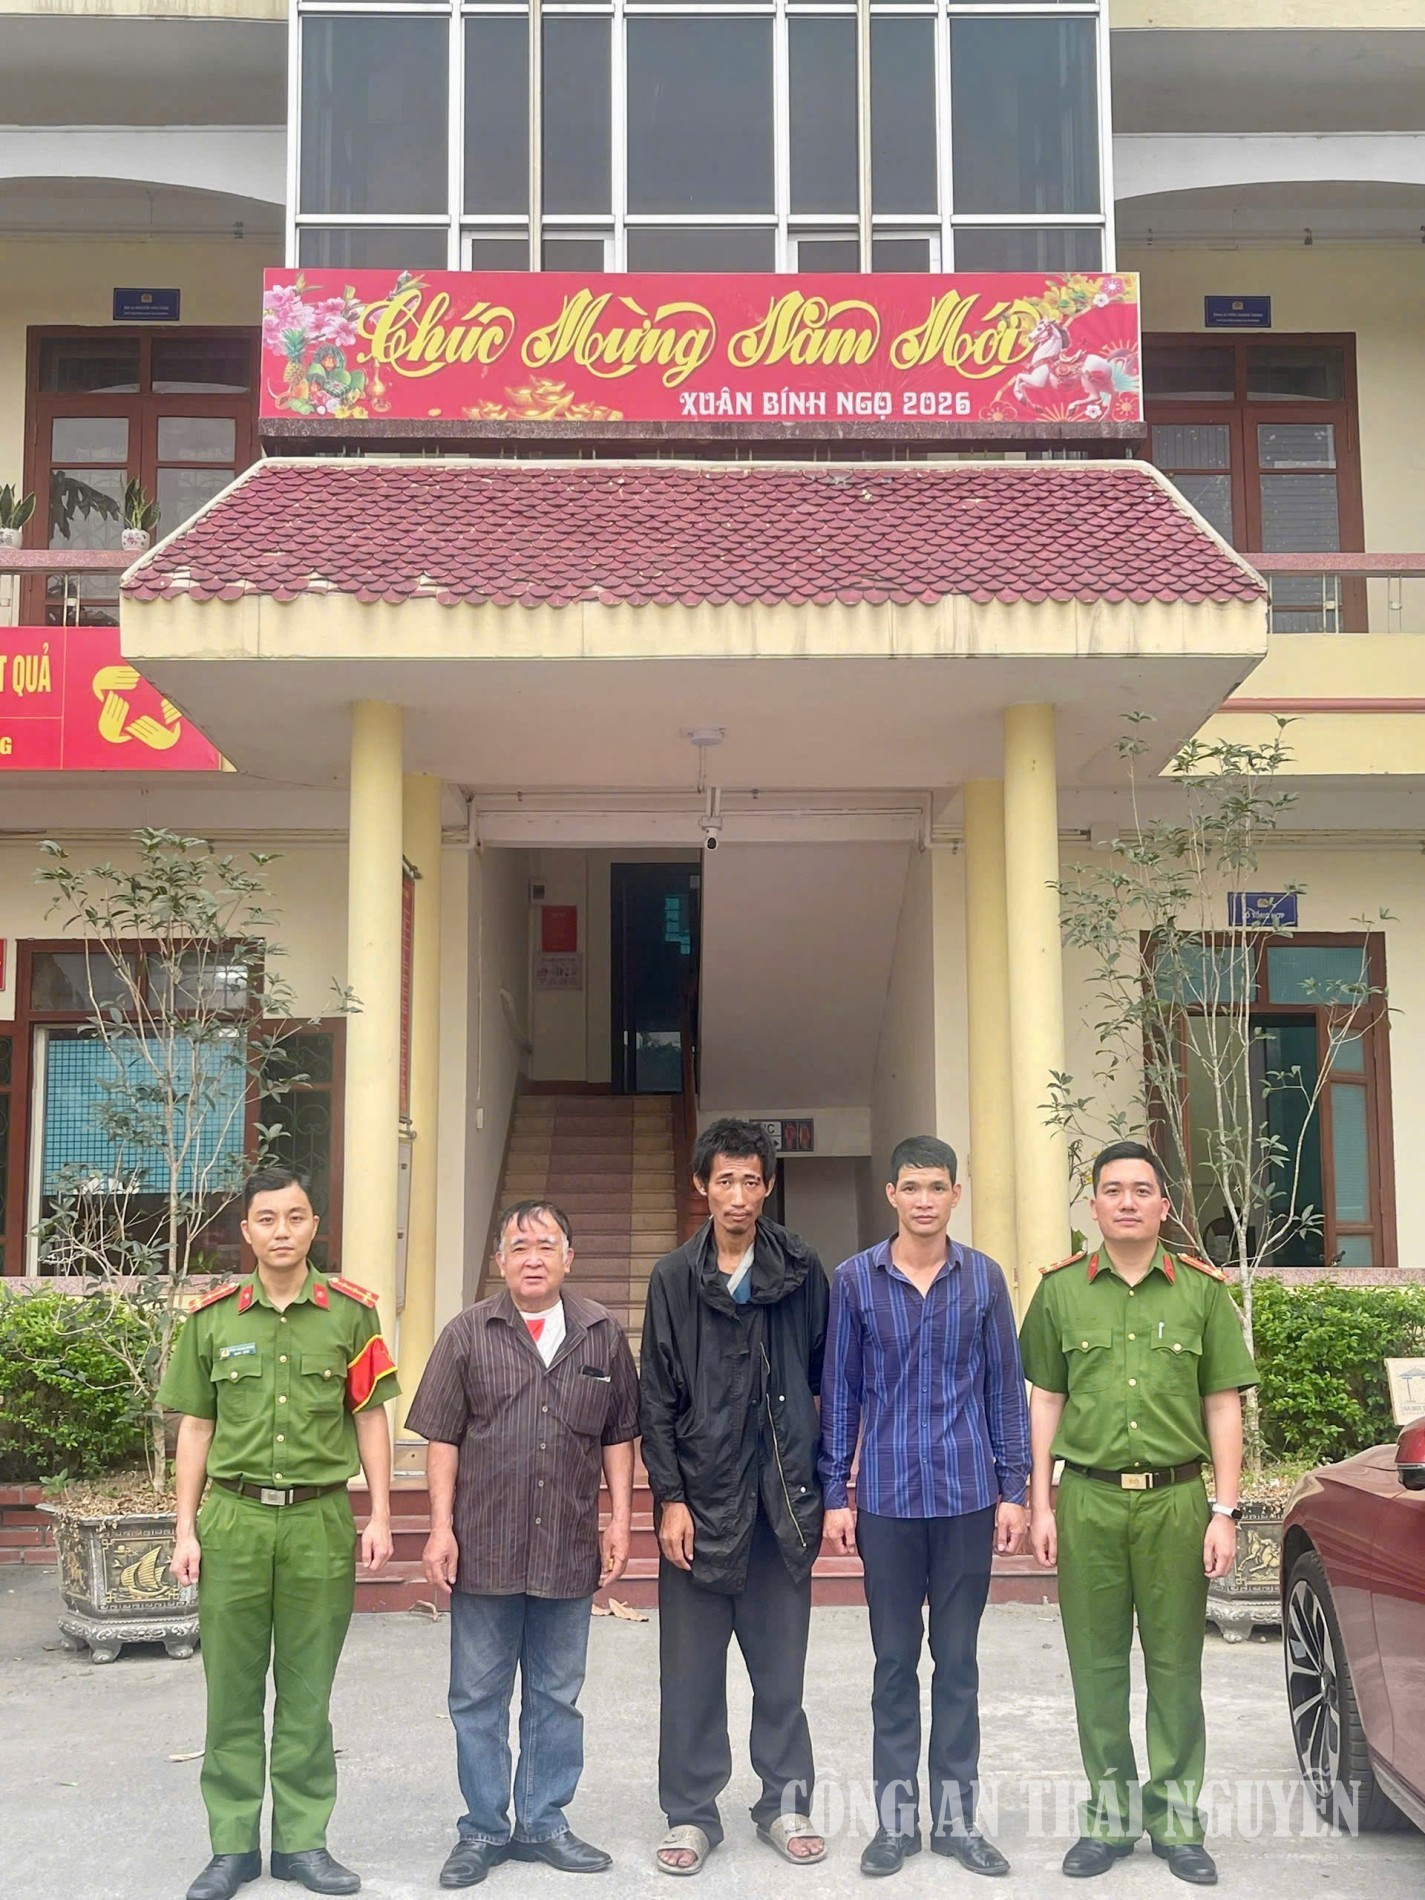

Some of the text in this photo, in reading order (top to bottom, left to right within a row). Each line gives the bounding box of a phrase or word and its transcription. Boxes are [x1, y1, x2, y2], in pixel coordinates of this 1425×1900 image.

[356, 288, 1036, 388] Chúc Mừng Năm Mới
[679, 387, 971, 420] XUÂN BÍNH NGỌ 2026
[12, 642, 51, 697] QUẢ
